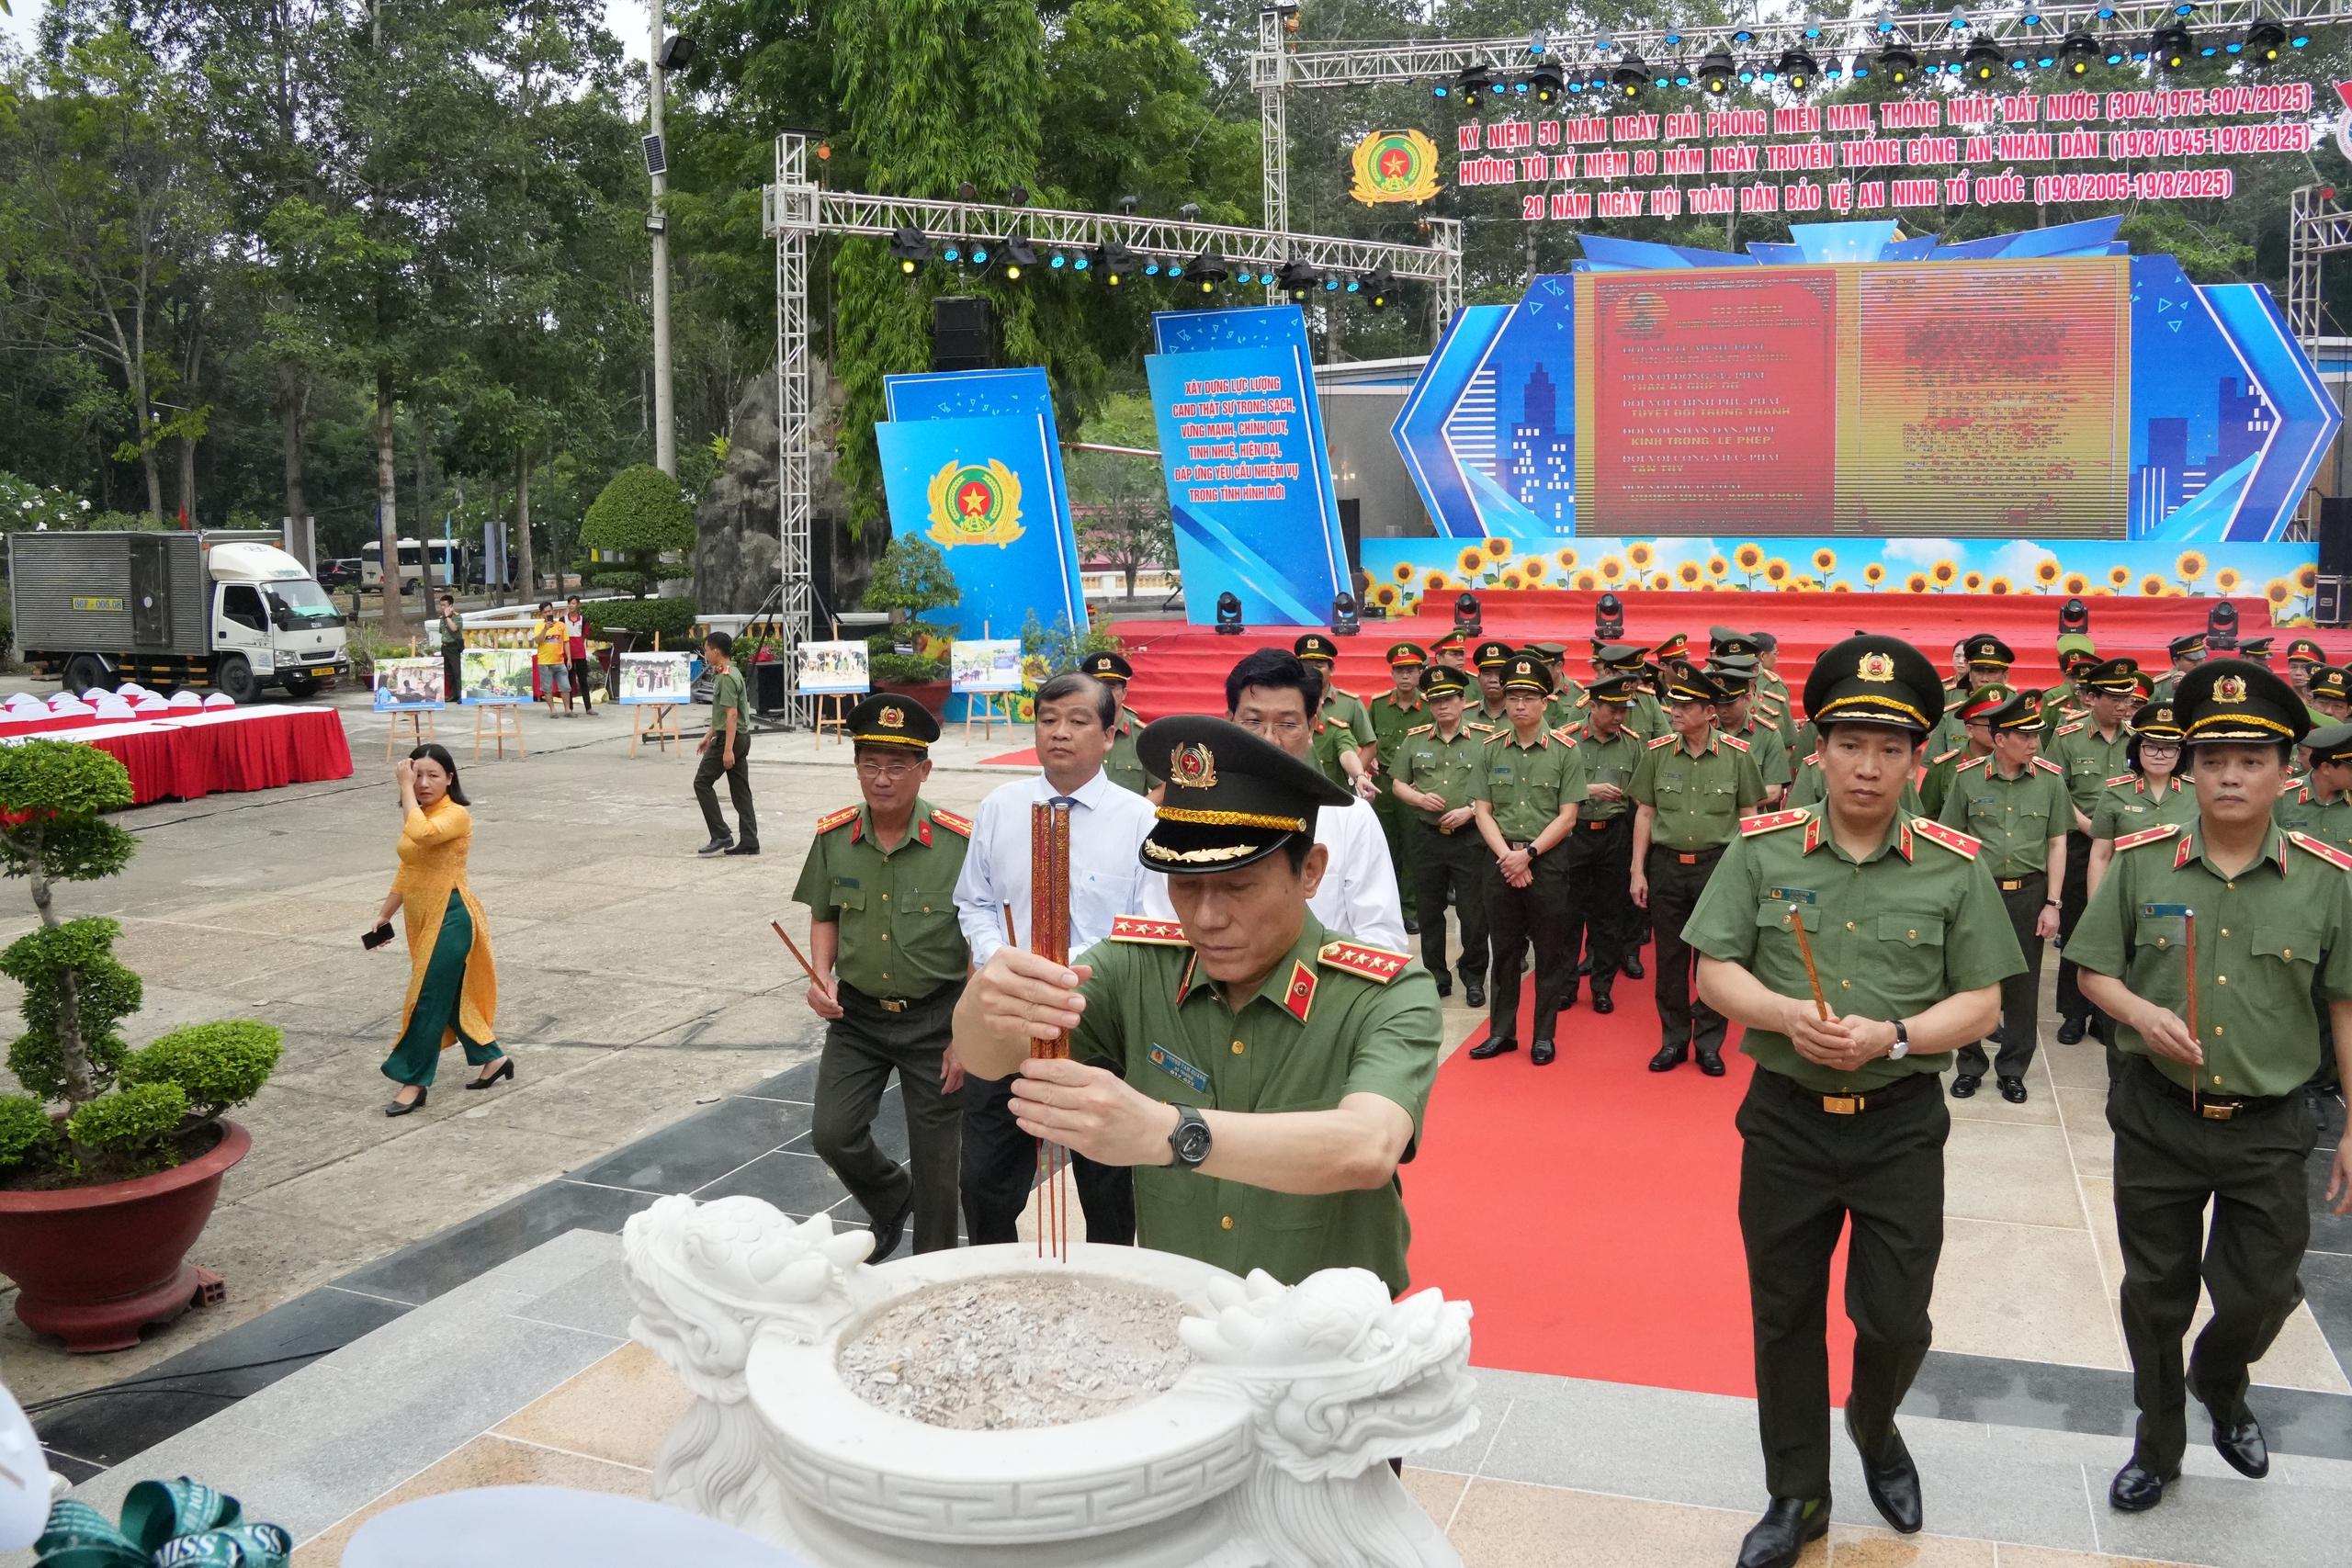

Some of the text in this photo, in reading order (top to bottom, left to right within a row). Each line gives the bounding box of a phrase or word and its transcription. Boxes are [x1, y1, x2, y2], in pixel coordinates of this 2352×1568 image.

[1459, 118, 1481, 152] KỶ
[1487, 122, 1531, 153] NIỆM
[1538, 121, 1559, 145] 50
[1566, 112, 1606, 144] NĂM
[1613, 109, 1658, 141] NGÀY
[1665, 105, 1701, 140] GIẢI
[1707, 105, 1766, 138] PHÓNG
[1773, 101, 1820, 134] MIỀN
[1827, 104, 1875, 134] NAM,
[1880, 93, 1939, 129] THỐNG
[1947, 89, 1995, 126] NHẤT
[2004, 87, 2039, 123] ĐẤT
[2048, 89, 2098, 121] NƯỚC
[1459, 156, 1516, 186] HƯỚNG
[1521, 153, 1548, 182] TỚI
[1555, 145, 1577, 181] KỶ
[1583, 152, 1629, 183] NIỆM
[1634, 150, 1657, 175] 80
[1664, 143, 1705, 175] NĂM
[1712, 140, 1759, 173] NGÀY
[1767, 135, 1834, 171] TRUYỀN
[1842, 131, 1901, 167] THỐNG
[1907, 131, 1956, 165] CÔNG
[1966, 135, 1992, 164] AN
[1999, 130, 2052, 162] NHÂN
[2059, 126, 2100, 160] DÂN
[1522, 195, 1544, 220] 20
[1551, 189, 1591, 220] NĂM
[1599, 186, 1645, 217] NGÀY
[1651, 187, 1681, 221] HỘI
[1688, 182, 1734, 214] TOÀN
[1741, 182, 1778, 212] DÂN
[1785, 175, 1821, 211] BẢO
[1828, 177, 1853, 215] VỆ
[1859, 181, 1884, 209] AN
[1891, 178, 1938, 207] NINH
[1945, 168, 1970, 204] TỔ
[1975, 165, 2024, 208] QUỐC
[1185, 377, 1281, 398] XÂY DỤNG LỰC LƯỢNG
[1172, 399, 1296, 419] CAND THẬT SỰ TRONG SẠCH,
[1182, 421, 1288, 440] VỮNG MẠNH, CHÍNH QUY,
[1189, 442, 1282, 460] TINH NHUỆ, HIỆN ĐẠI,
[1174, 467, 1192, 481] ĐÁP
[1194, 466, 1213, 480] ỨNG
[1216, 465, 1232, 479] YÊU
[1254, 463, 1284, 481] NHIỆM
[1286, 463, 1298, 480] VỤ
[1189, 483, 1285, 502] TRONG TÌNH HÌNH MỚI
